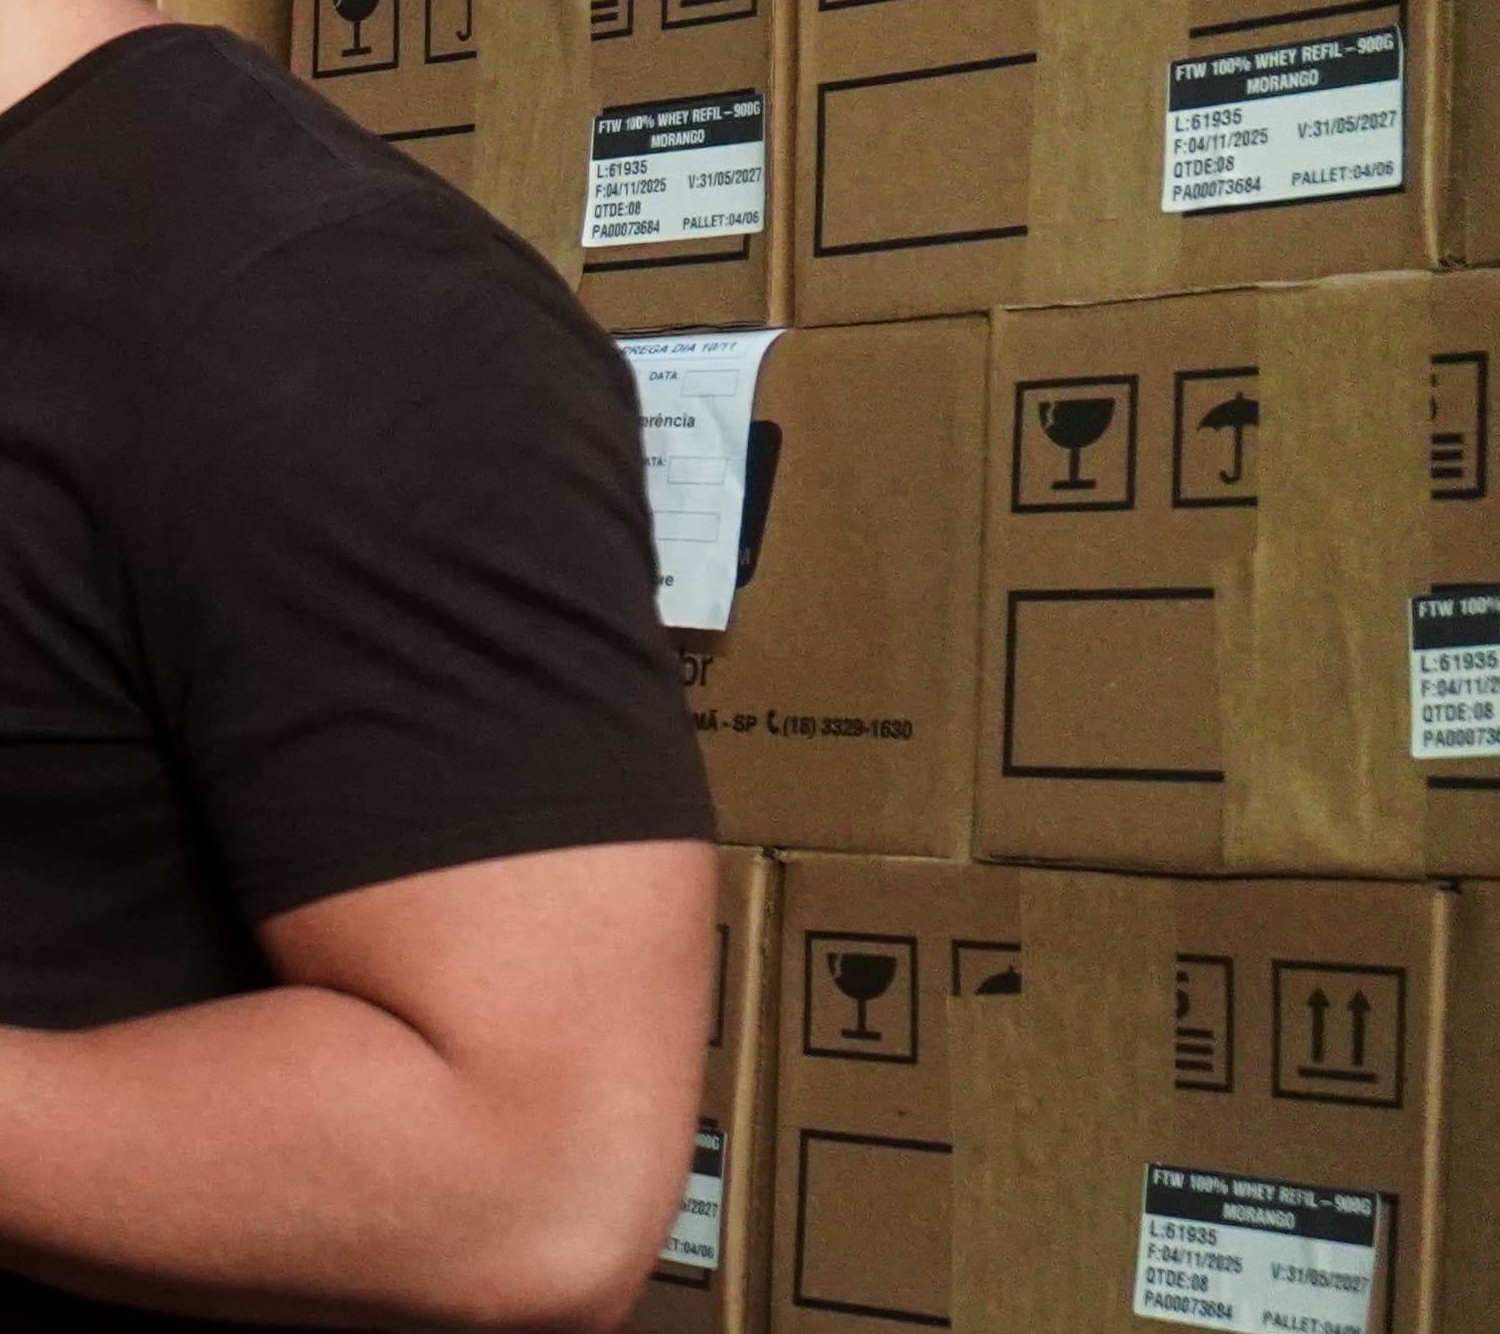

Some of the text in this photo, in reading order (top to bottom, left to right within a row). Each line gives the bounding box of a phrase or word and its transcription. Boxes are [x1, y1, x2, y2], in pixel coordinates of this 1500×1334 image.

[1175, 34, 1394, 82] FTW 100% WHEY REFIL 900G
[1247, 69, 1320, 95] MORANGO
[599, 101, 760, 134] FTW 100% WHEY REFIL 900G
[1175, 109, 1243, 133] L:61935
[1297, 111, 1397, 139] V:31/05/2027
[651, 129, 705, 148] MORANGO
[1174, 128, 1268, 154] F:04/11/2025
[597, 160, 648, 178] L:61935
[689, 167, 762, 189] V:31/05/2027
[1174, 156, 1235, 178] QTDE:08
[1292, 161, 1394, 187] PALLET:04/06
[595, 178, 666, 198] F:04/11/2025
[1172, 177, 1261, 202] PA00073684
[594, 201, 641, 218] QTDE:08
[683, 211, 759, 230] PALLET:04/06
[592, 220, 660, 239] PA00073684
[673, 344, 696, 353] DIA
[1418, 600, 1454, 618] FTW
[1420, 650, 1499, 673] L:61935
[1422, 702, 1494, 722] QTDE:08
[733, 714, 913, 739] SP (18) 3329-1630
[1153, 1169, 1184, 1189] FTW
[1190, 1174, 1229, 1196] 100%
[1232, 1179, 1275, 1202] WHEY
[1222, 1202, 1295, 1229] MORANGO
[1150, 1220, 1218, 1246] L:61935
[1148, 1244, 1243, 1274] F:04/11/2025
[1146, 1268, 1209, 1292] QTDE:08
[1271, 1262, 1370, 1293] V:31/05/2027
[1145, 1291, 1233, 1319] PA00073684
